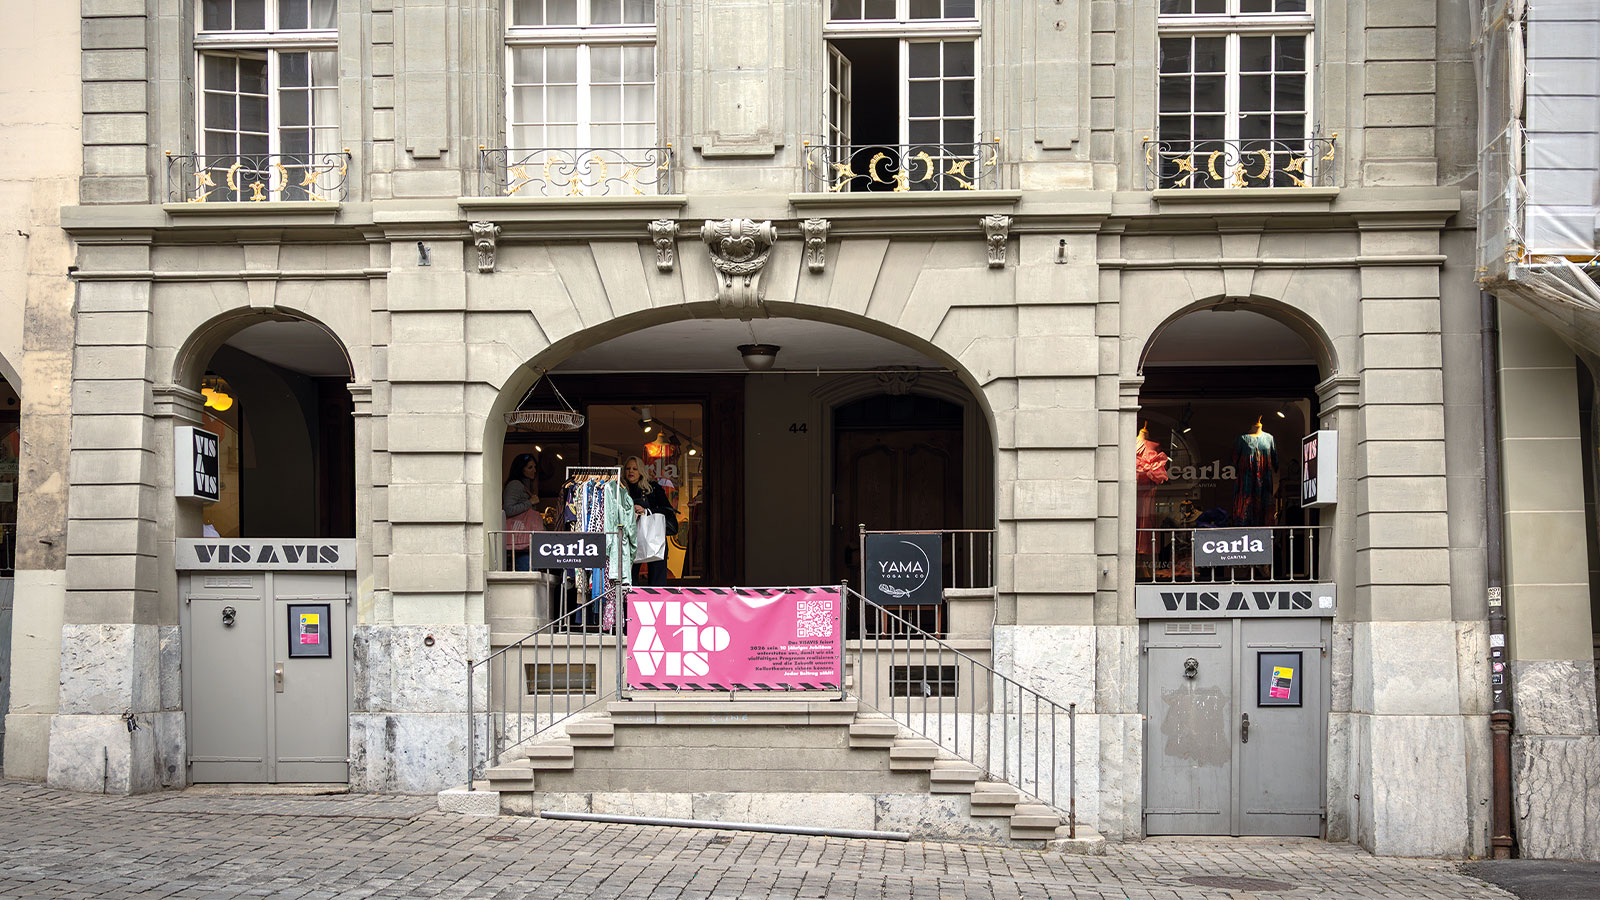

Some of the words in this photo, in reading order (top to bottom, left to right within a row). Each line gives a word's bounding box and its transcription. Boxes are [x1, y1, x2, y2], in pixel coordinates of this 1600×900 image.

[789, 423, 808, 433] 44
[195, 434, 217, 457] VIS
[1303, 439, 1317, 462] VIS
[195, 454, 205, 473] A
[1166, 460, 1237, 480] carla
[1303, 462, 1309, 481] A
[195, 472, 217, 495] VIS
[1303, 478, 1316, 499] VIS
[539, 538, 599, 556] carla
[1202, 534, 1264, 553] carla
[194, 545, 251, 563] VIS
[257, 545, 279, 563] A
[282, 545, 340, 563] VIS
[879, 561, 924, 573] YAMA
[1160, 592, 1220, 610] VIS
[1226, 592, 1250, 610] A
[1252, 591, 1312, 610] VIS
[633, 601, 709, 625] VIS
[632, 626, 665, 651] A
[672, 626, 730, 651] 10
[633, 652, 709, 676] VIS
